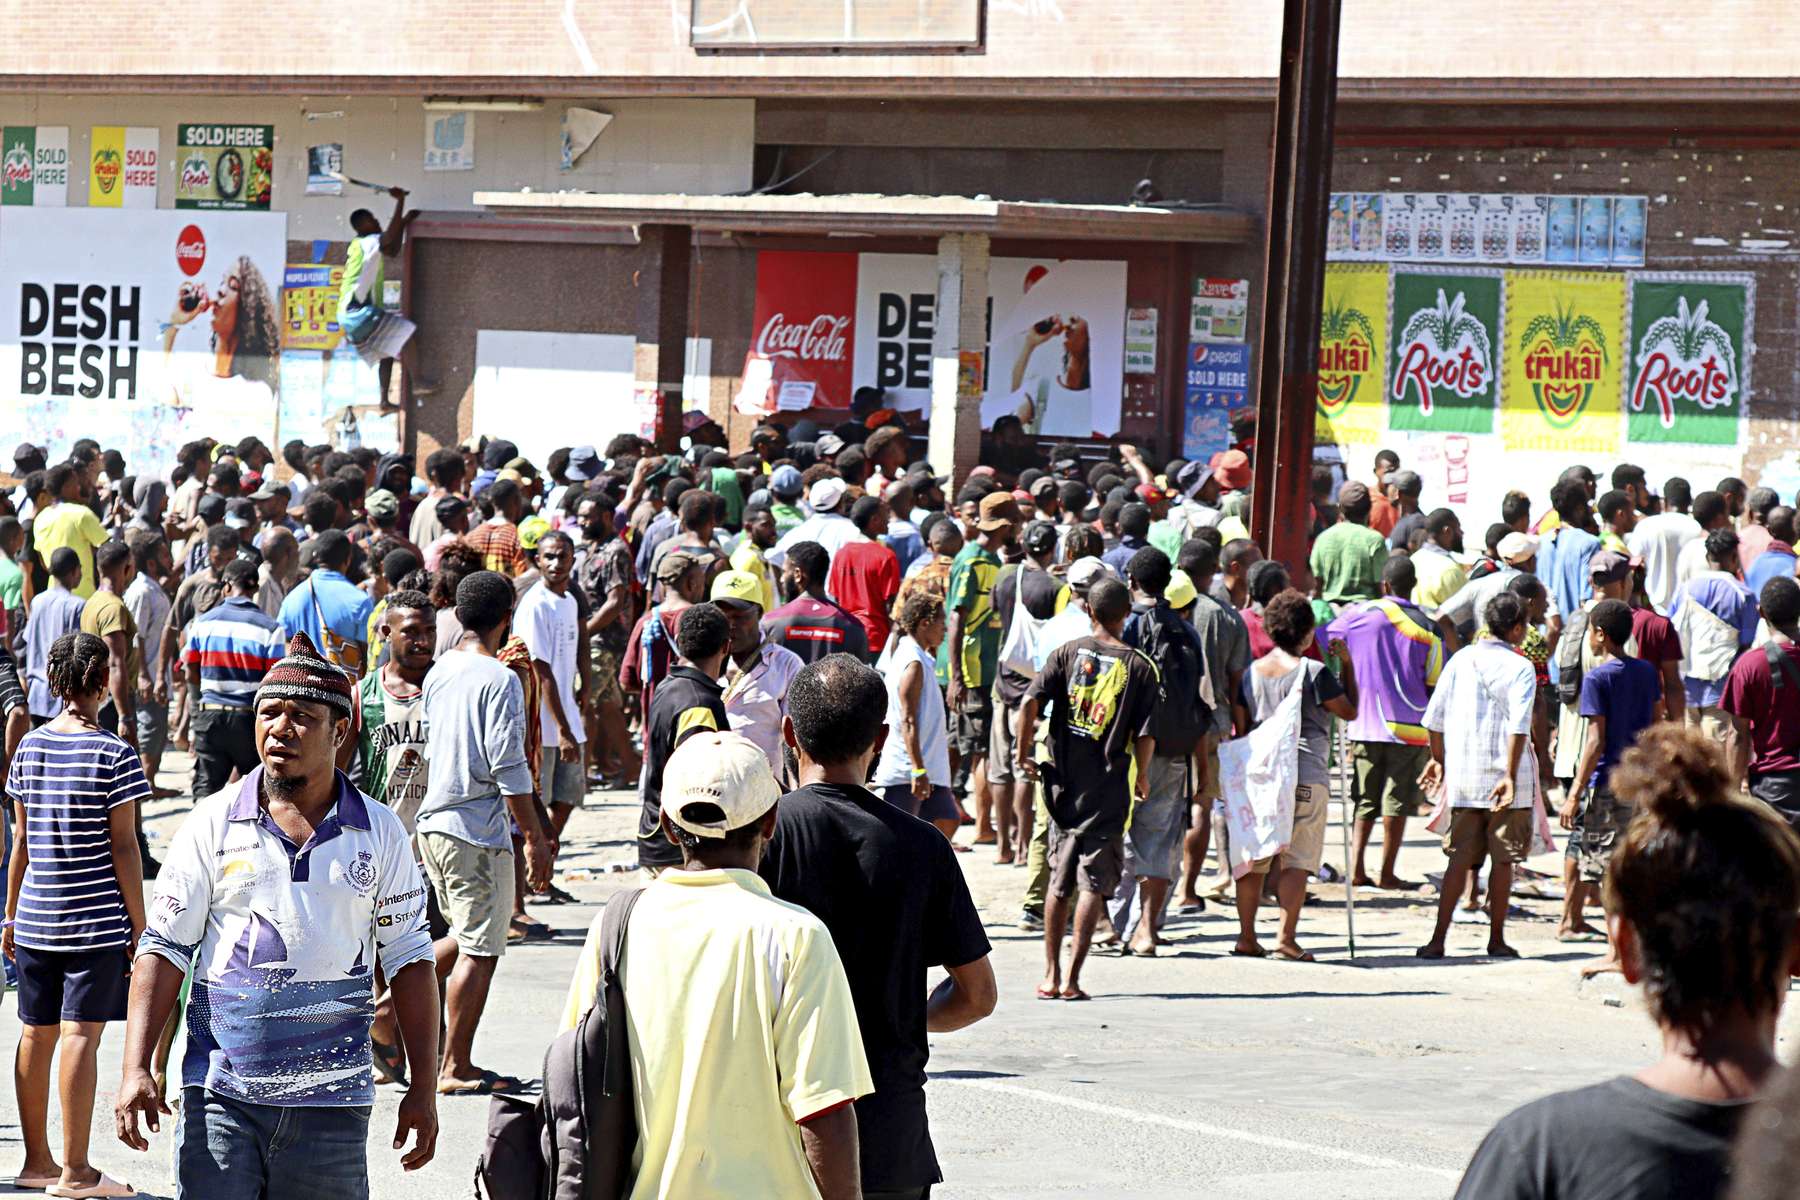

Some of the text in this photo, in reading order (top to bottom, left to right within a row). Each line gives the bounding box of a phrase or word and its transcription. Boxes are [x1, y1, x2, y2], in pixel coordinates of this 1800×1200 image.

[186, 127, 264, 146] SOLD HERE
[36, 149, 66, 164] SOLD
[127, 150, 157, 166] SOLD
[36, 169, 65, 184] HERE
[125, 171, 156, 187] HERE
[20, 282, 141, 342] DESH
[757, 313, 850, 360] Coca-Cola
[1209, 350, 1242, 364] pepsi
[1319, 341, 1369, 372] ukai
[1525, 349, 1602, 380] trukai
[20, 341, 138, 400] BESH
[1187, 370, 1247, 388] SOLD HERE
[1396, 343, 1485, 411] Roots
[1635, 353, 1729, 422] Roots
[371, 720, 427, 754] SINAL
[388, 783, 428, 801] MEXICO
